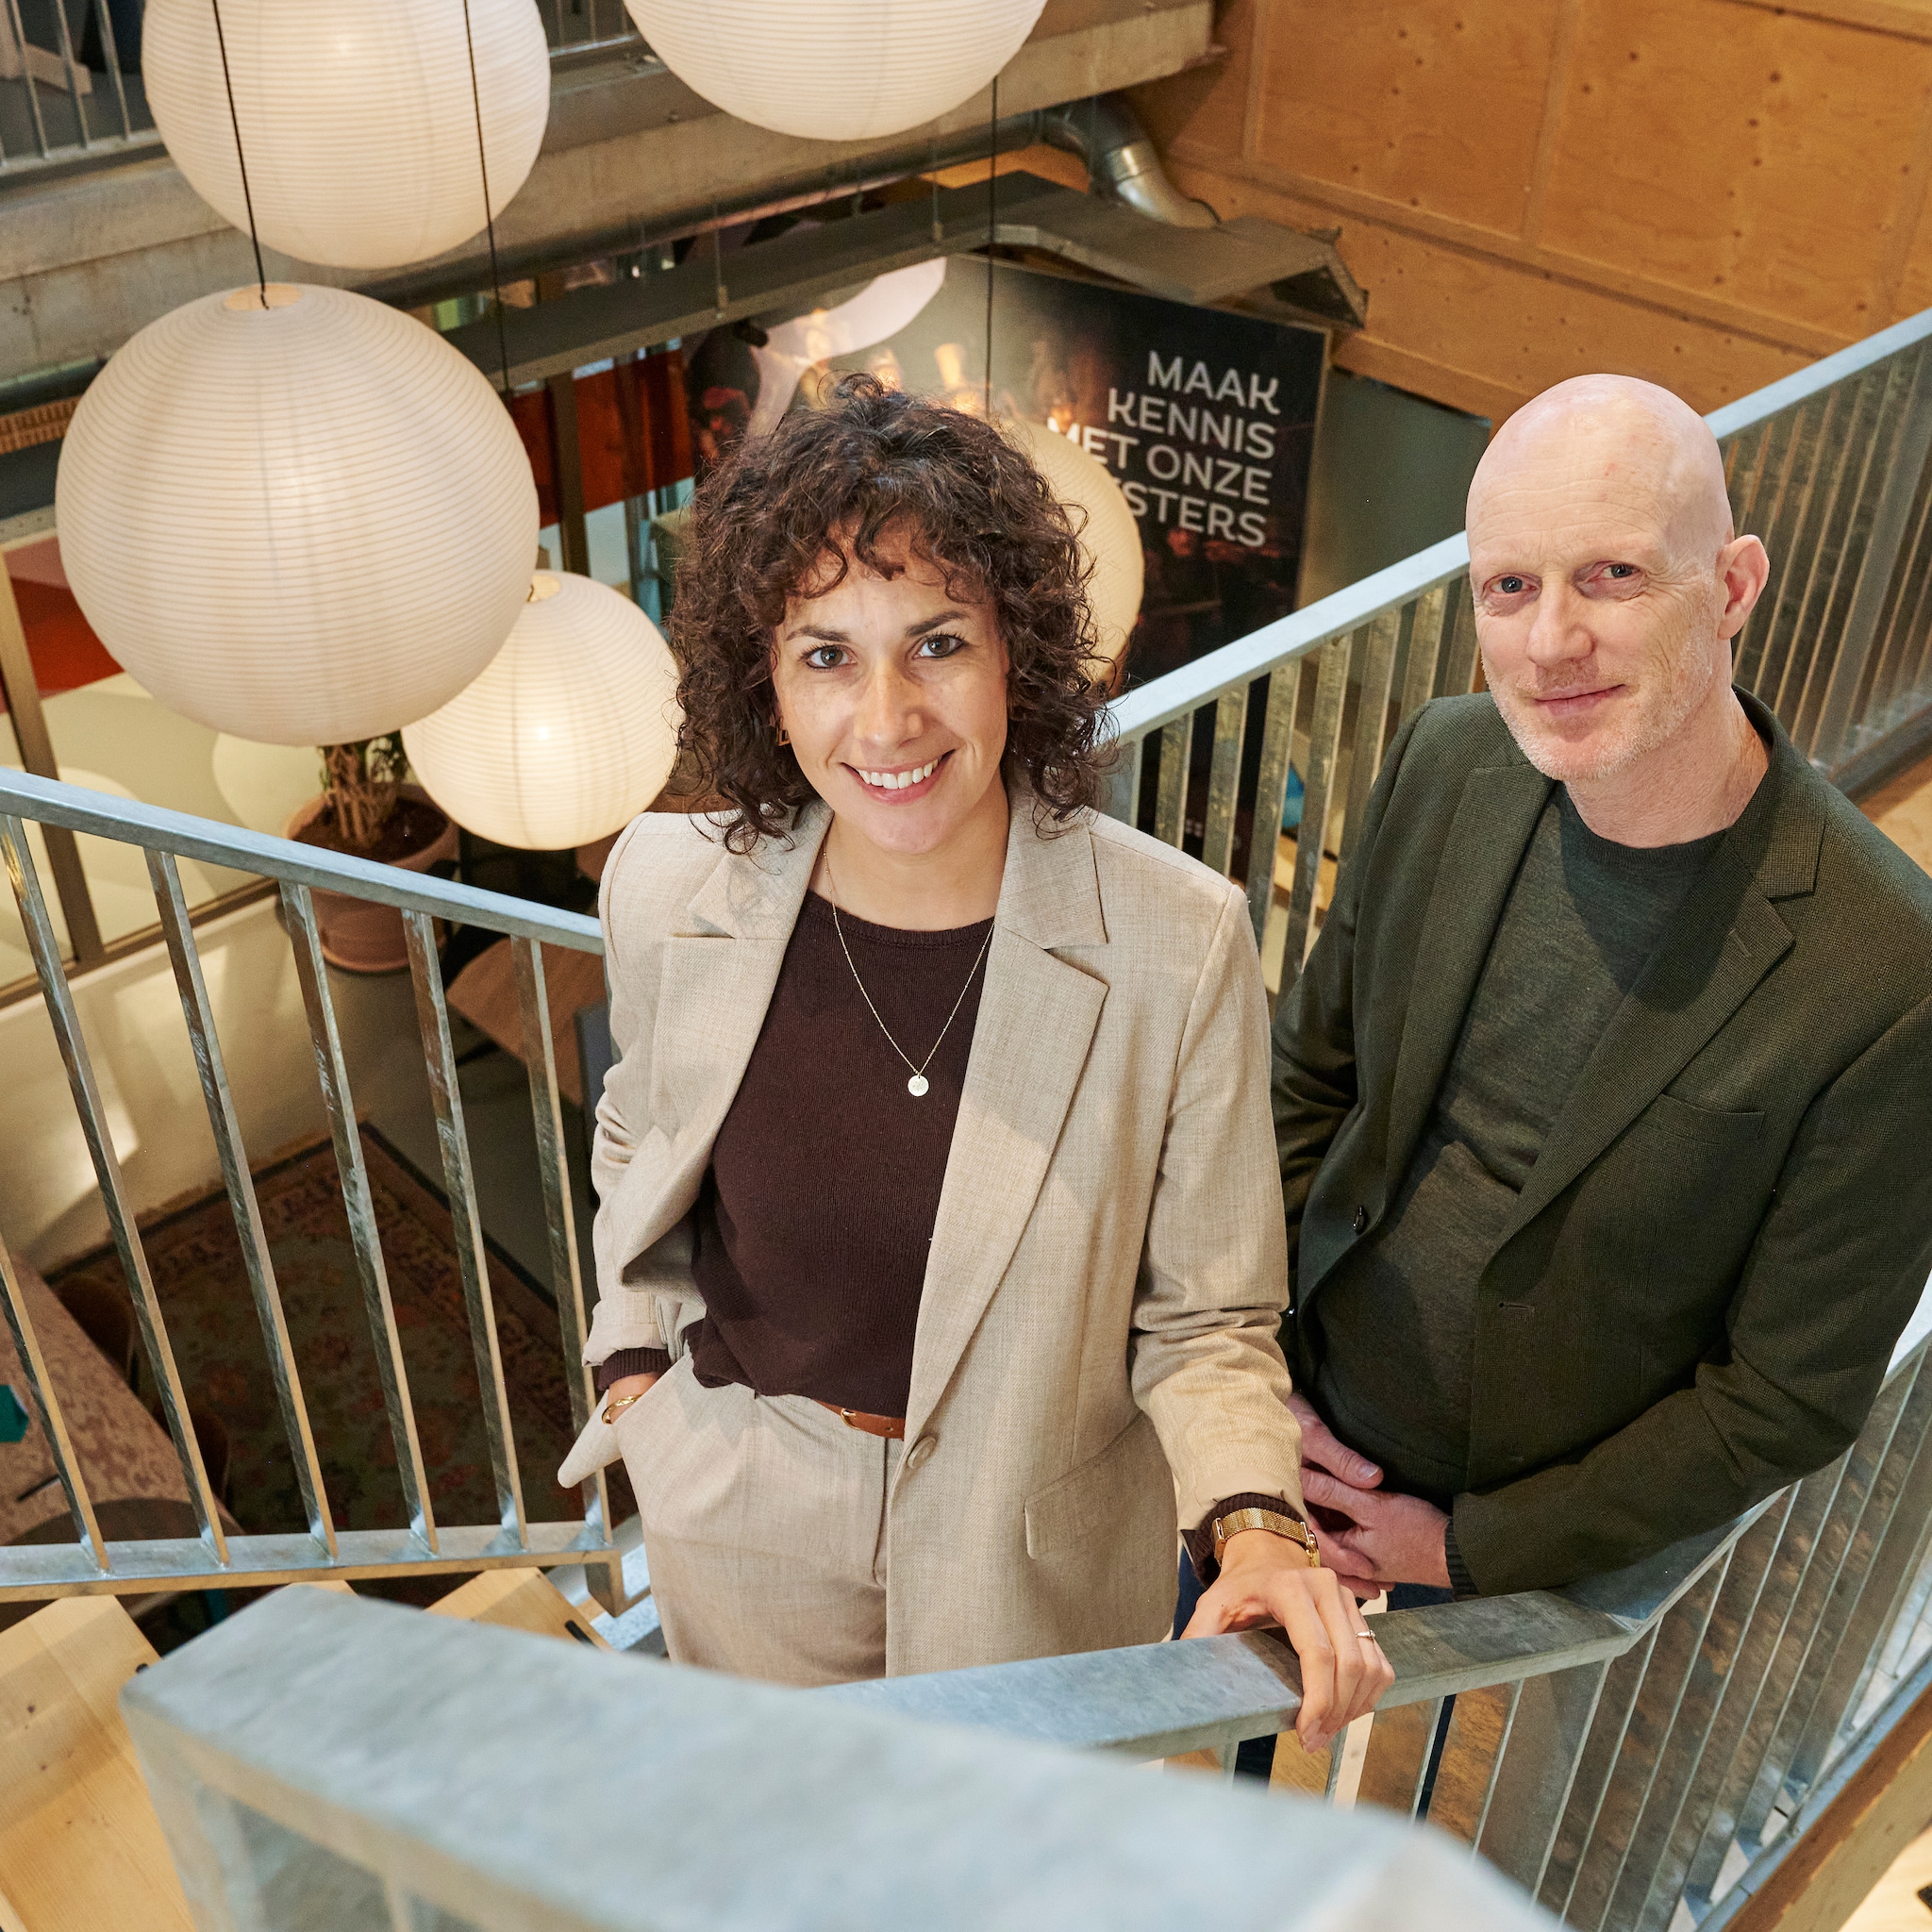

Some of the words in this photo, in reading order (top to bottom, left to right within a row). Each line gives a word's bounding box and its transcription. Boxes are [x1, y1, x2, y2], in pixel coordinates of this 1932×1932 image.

[1148, 351, 1281, 415] MAAK
[1108, 388, 1277, 459] KENNIS
[1146, 444, 1273, 505] ONZE
[1114, 476, 1266, 547] STERS
